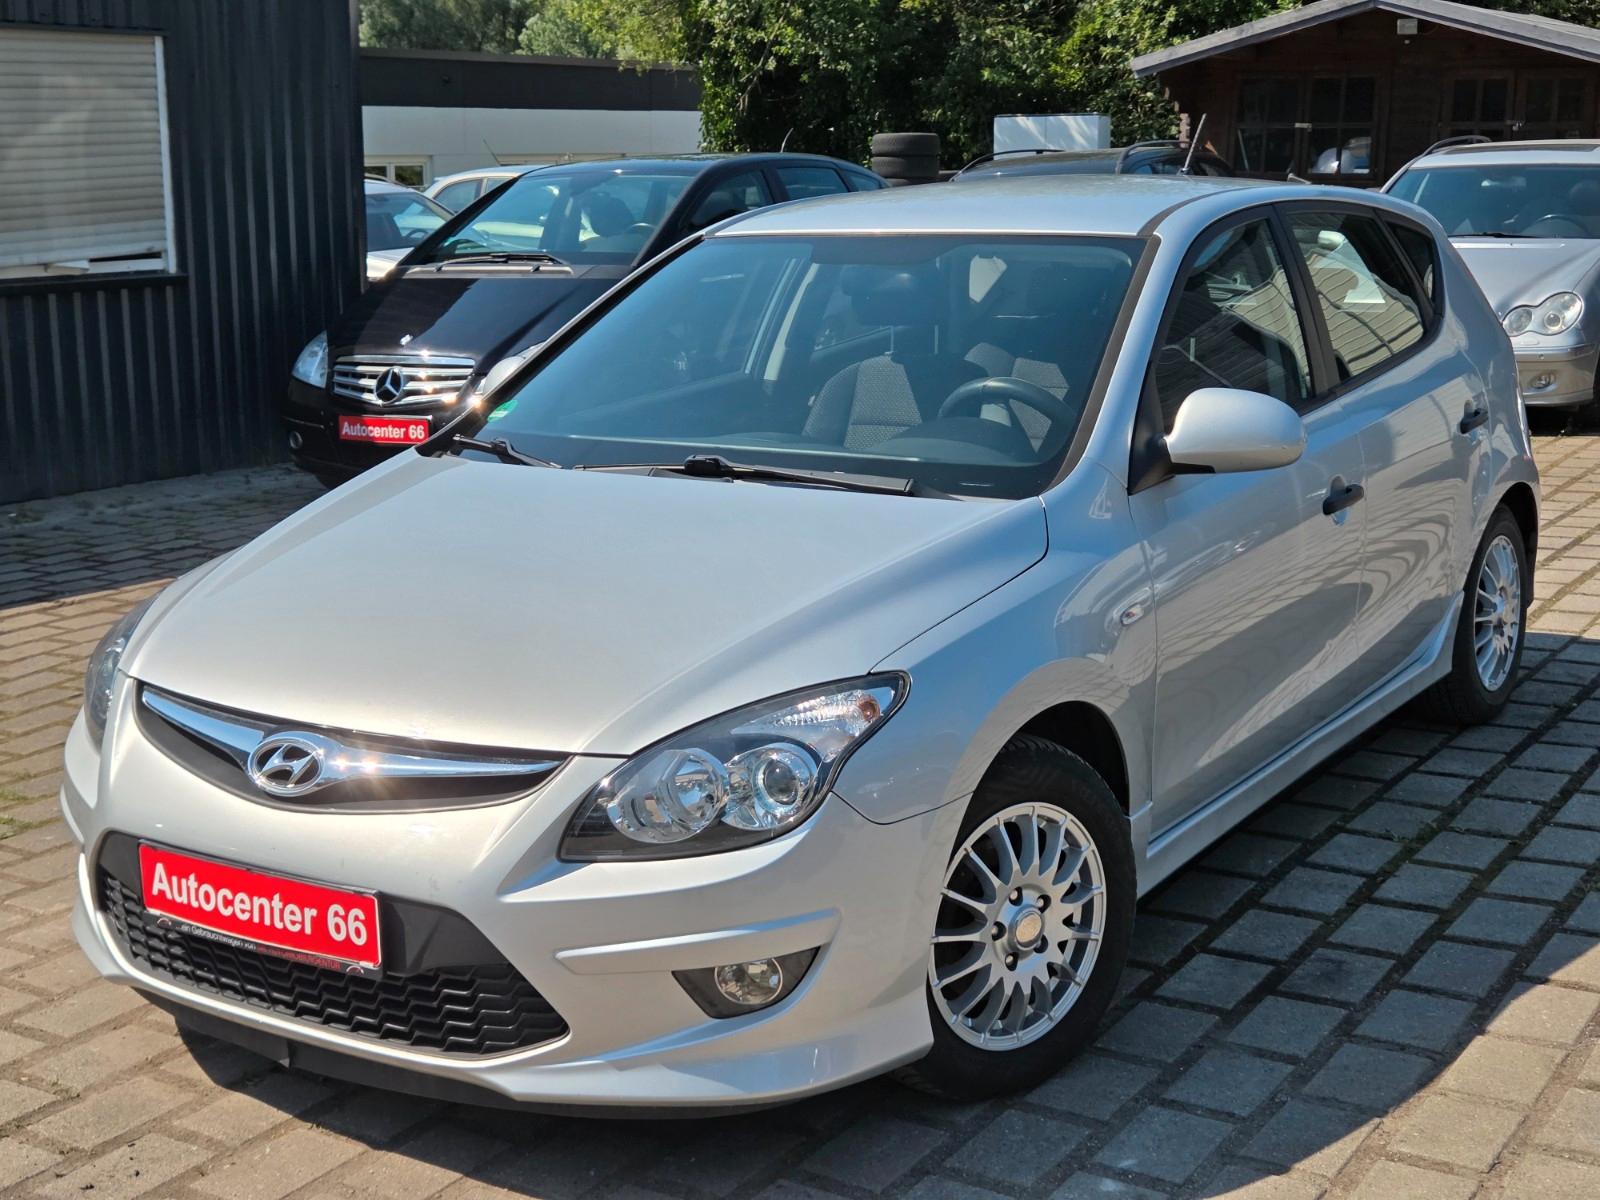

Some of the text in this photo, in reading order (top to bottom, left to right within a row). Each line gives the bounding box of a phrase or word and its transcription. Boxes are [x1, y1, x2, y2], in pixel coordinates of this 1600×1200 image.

[342, 421, 425, 439] Autocenter 66
[152, 863, 367, 945] Autocenter 66
